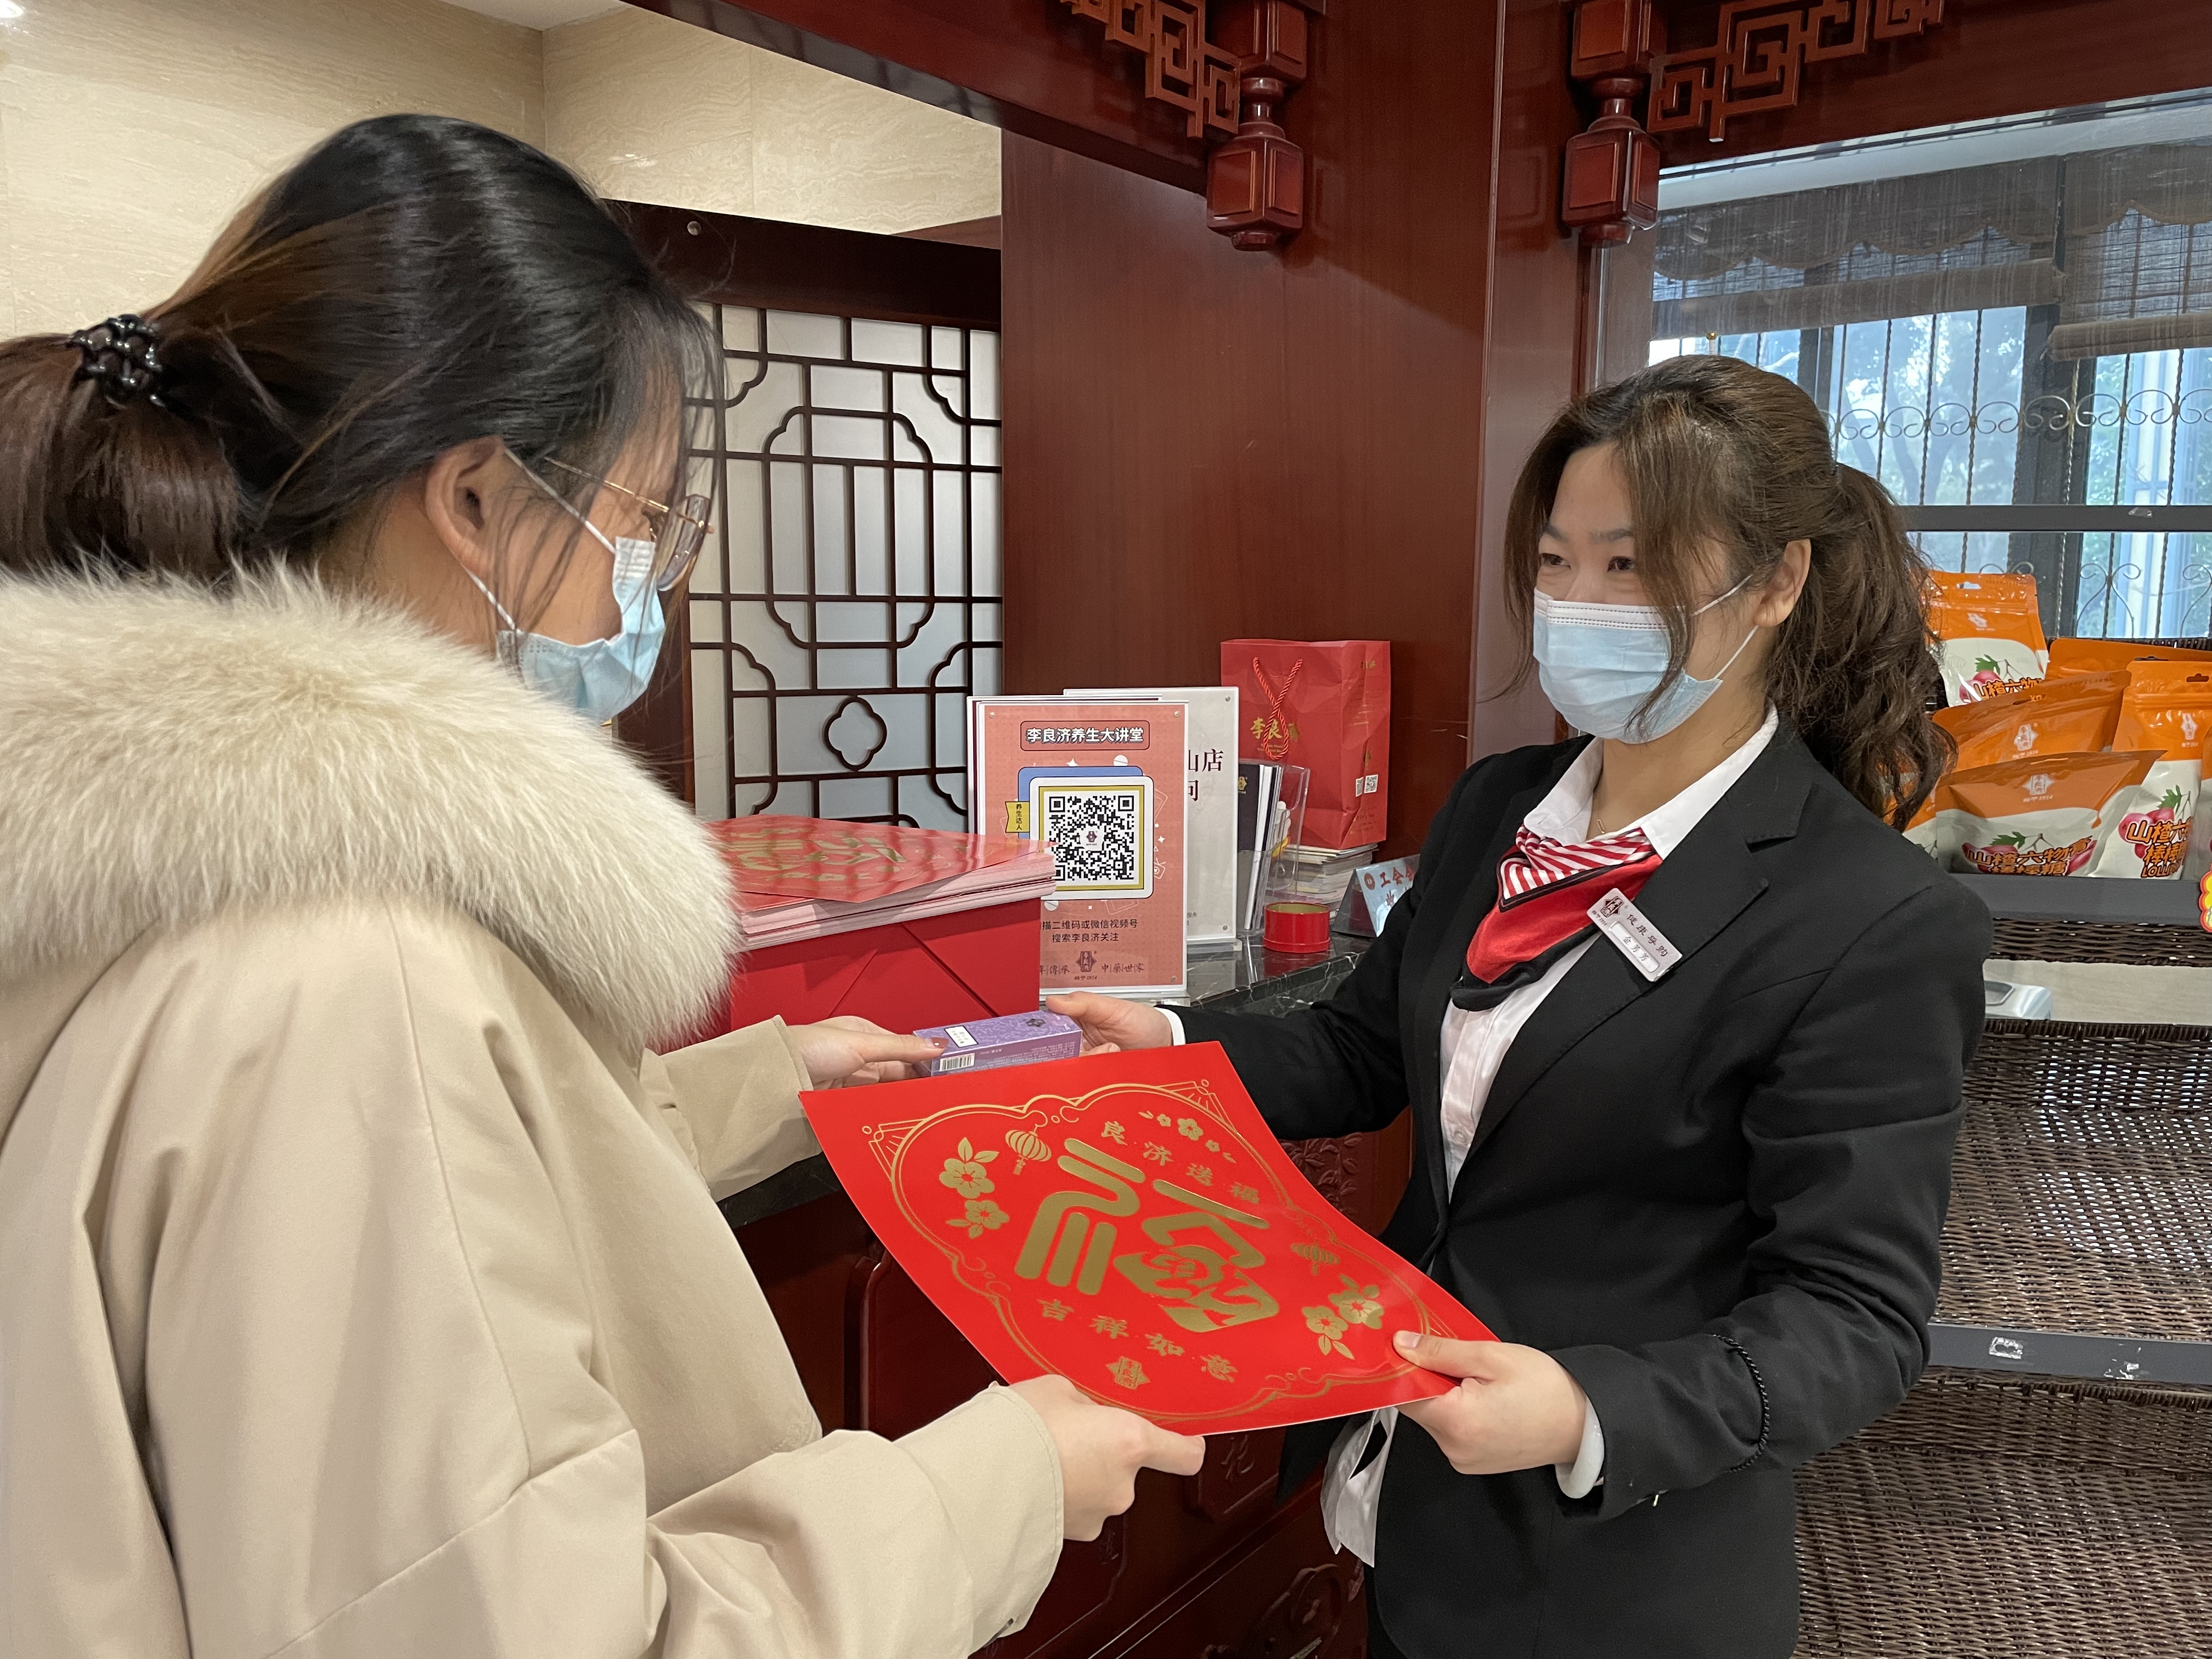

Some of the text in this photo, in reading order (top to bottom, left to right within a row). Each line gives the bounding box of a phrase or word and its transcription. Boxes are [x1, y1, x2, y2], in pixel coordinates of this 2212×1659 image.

[1026, 727, 1144, 744] 李良济养生大讲堂
[1040, 919, 1138, 930] 描二维码或微信视频号
[1052, 933, 1119, 943] 搜索李良济关注
[1626, 914, 1668, 957] 健康导购
